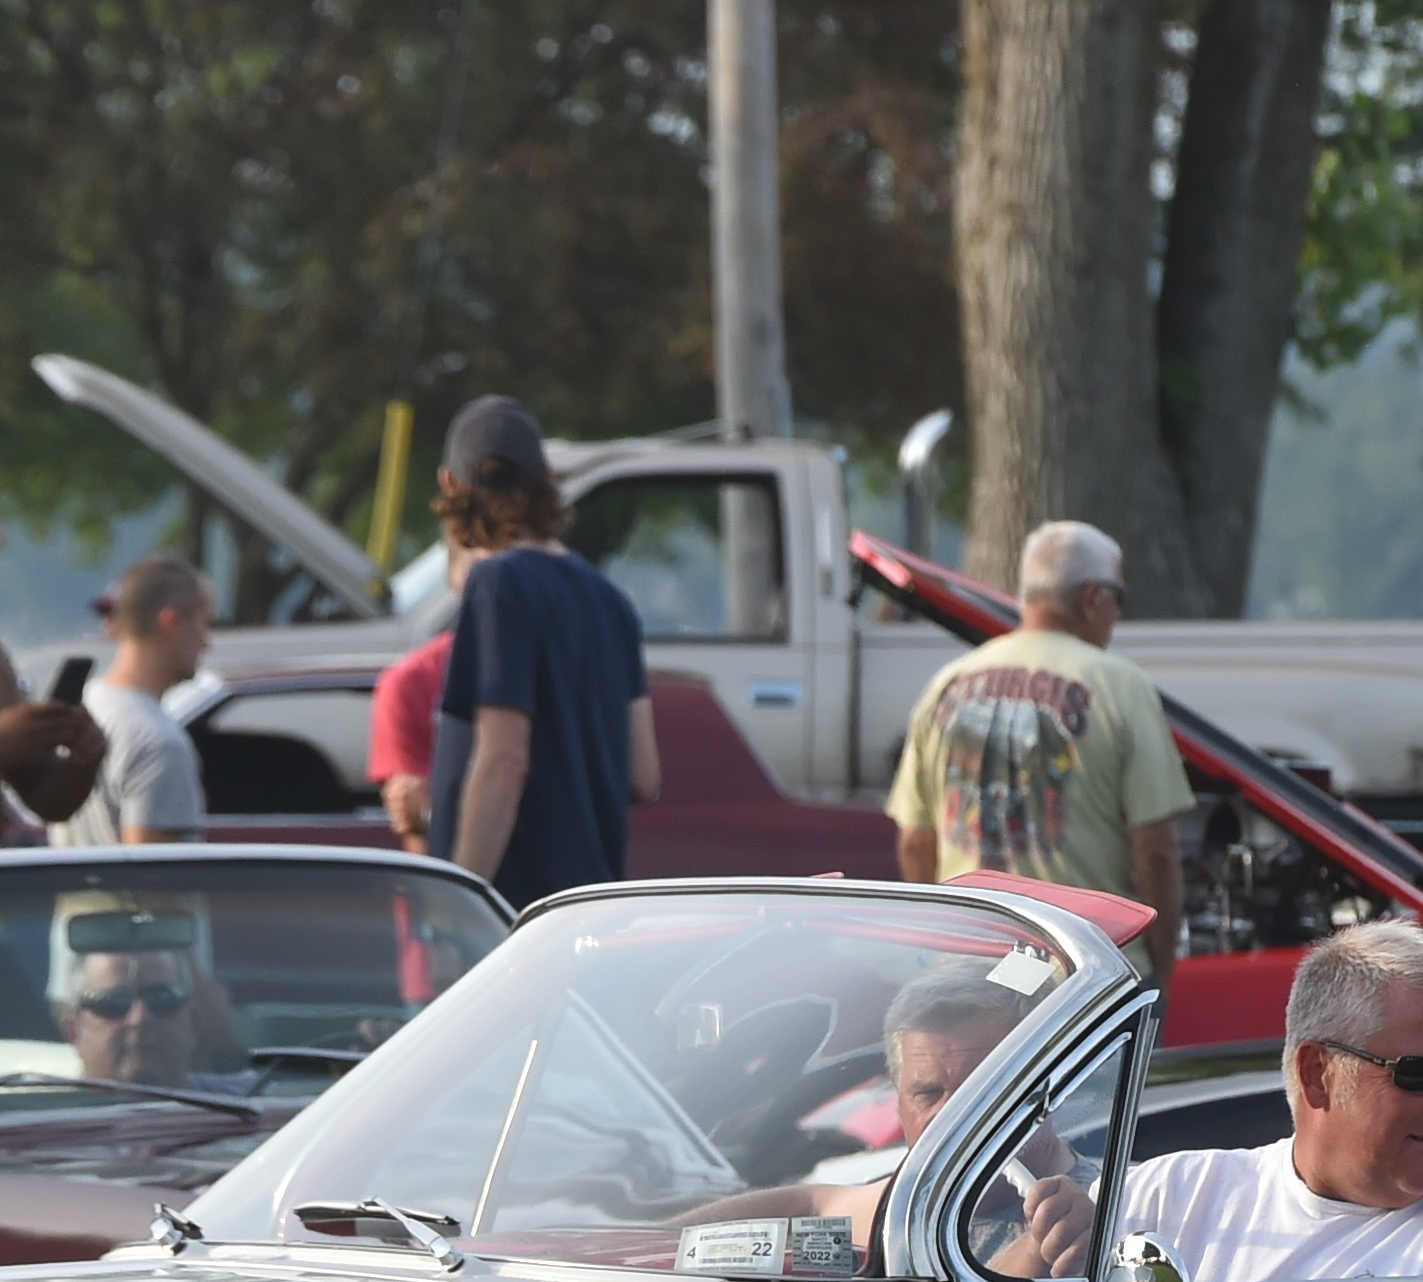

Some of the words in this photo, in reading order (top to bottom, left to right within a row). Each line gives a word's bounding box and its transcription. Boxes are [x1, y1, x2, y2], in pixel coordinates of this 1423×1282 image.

[686, 1246, 697, 1258] 4
[751, 1242, 773, 1257] 22
[803, 1251, 831, 1260] 2022
